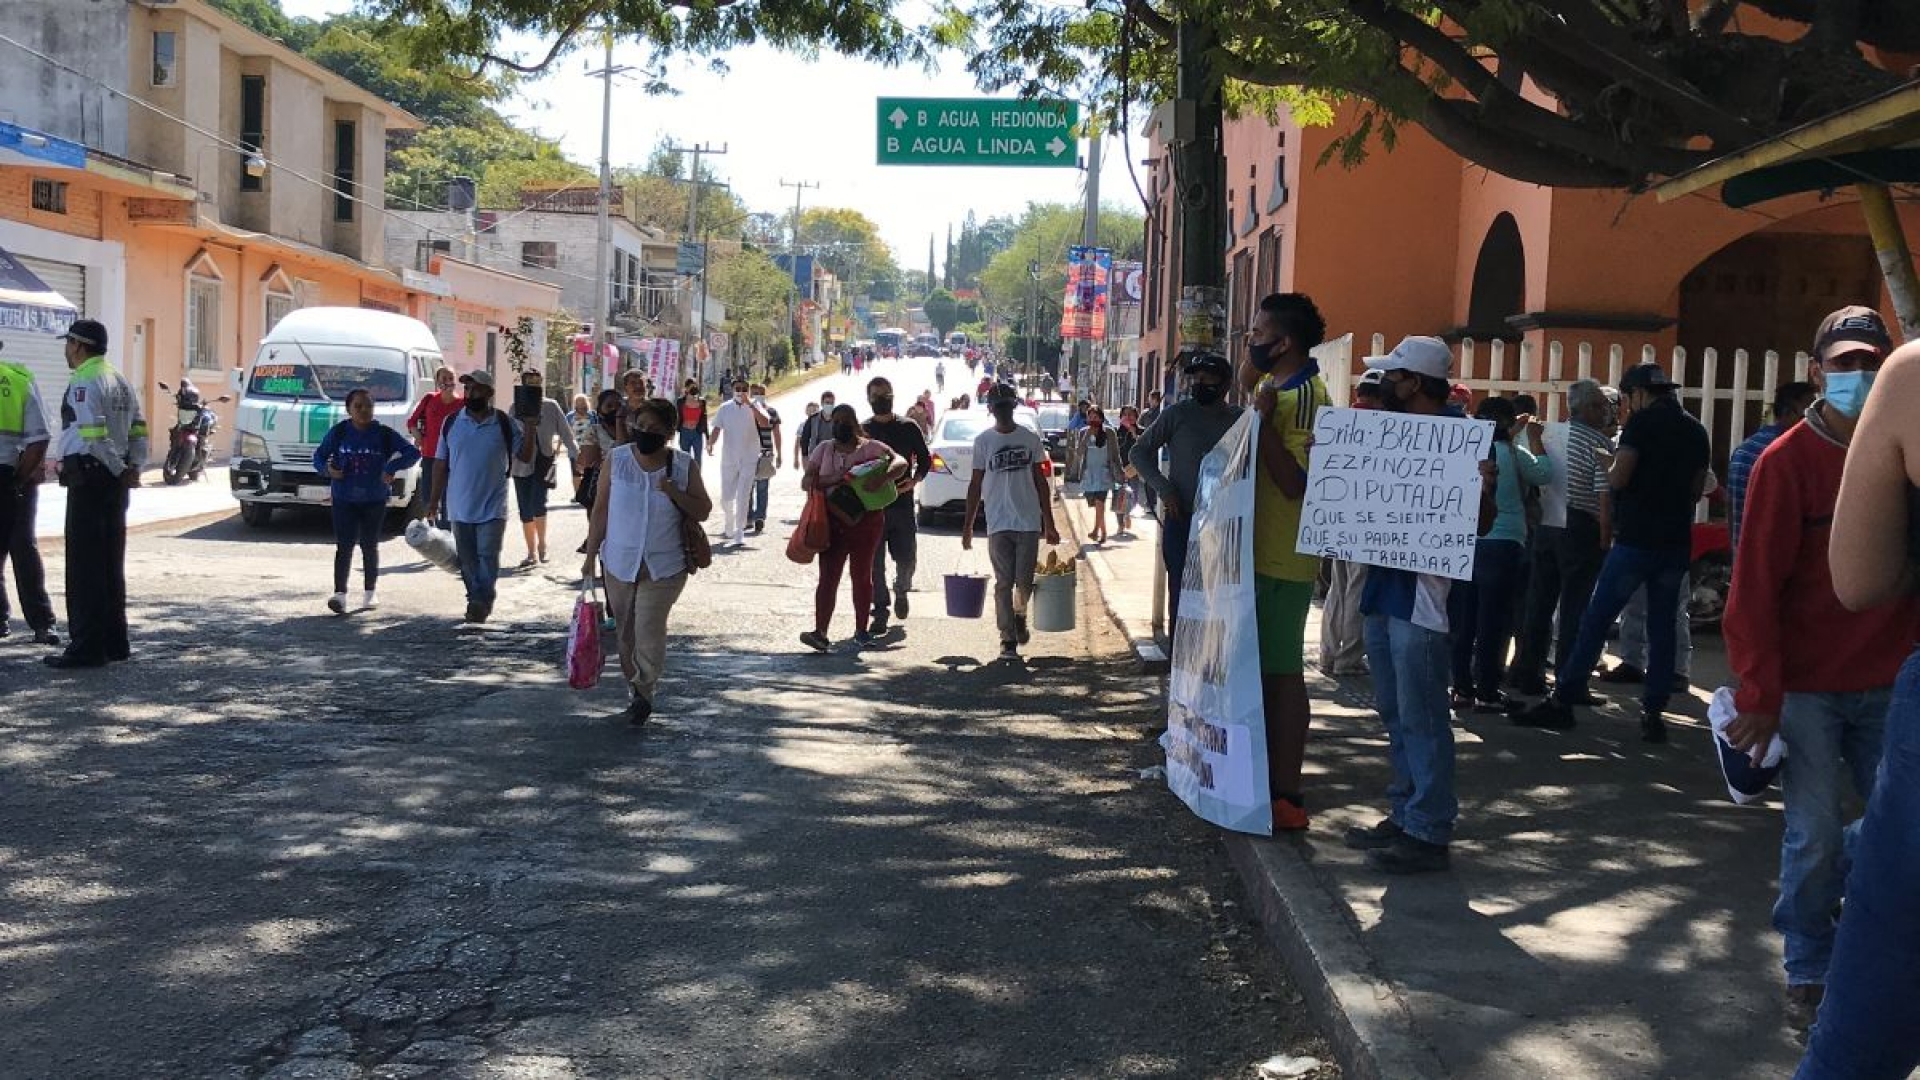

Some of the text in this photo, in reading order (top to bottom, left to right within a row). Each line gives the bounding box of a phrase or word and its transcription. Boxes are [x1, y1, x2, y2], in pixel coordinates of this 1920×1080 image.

[917, 110, 1068, 128] B AGUA HEDIONDA
[887, 137, 1037, 155] B AGUA LINDA
[261, 405, 278, 432] 12
[1323, 453, 1446, 481] EZPINOZA
[1356, 511, 1377, 524] SE
[1301, 526, 1476, 550] QUE SU PADRE COBRE
